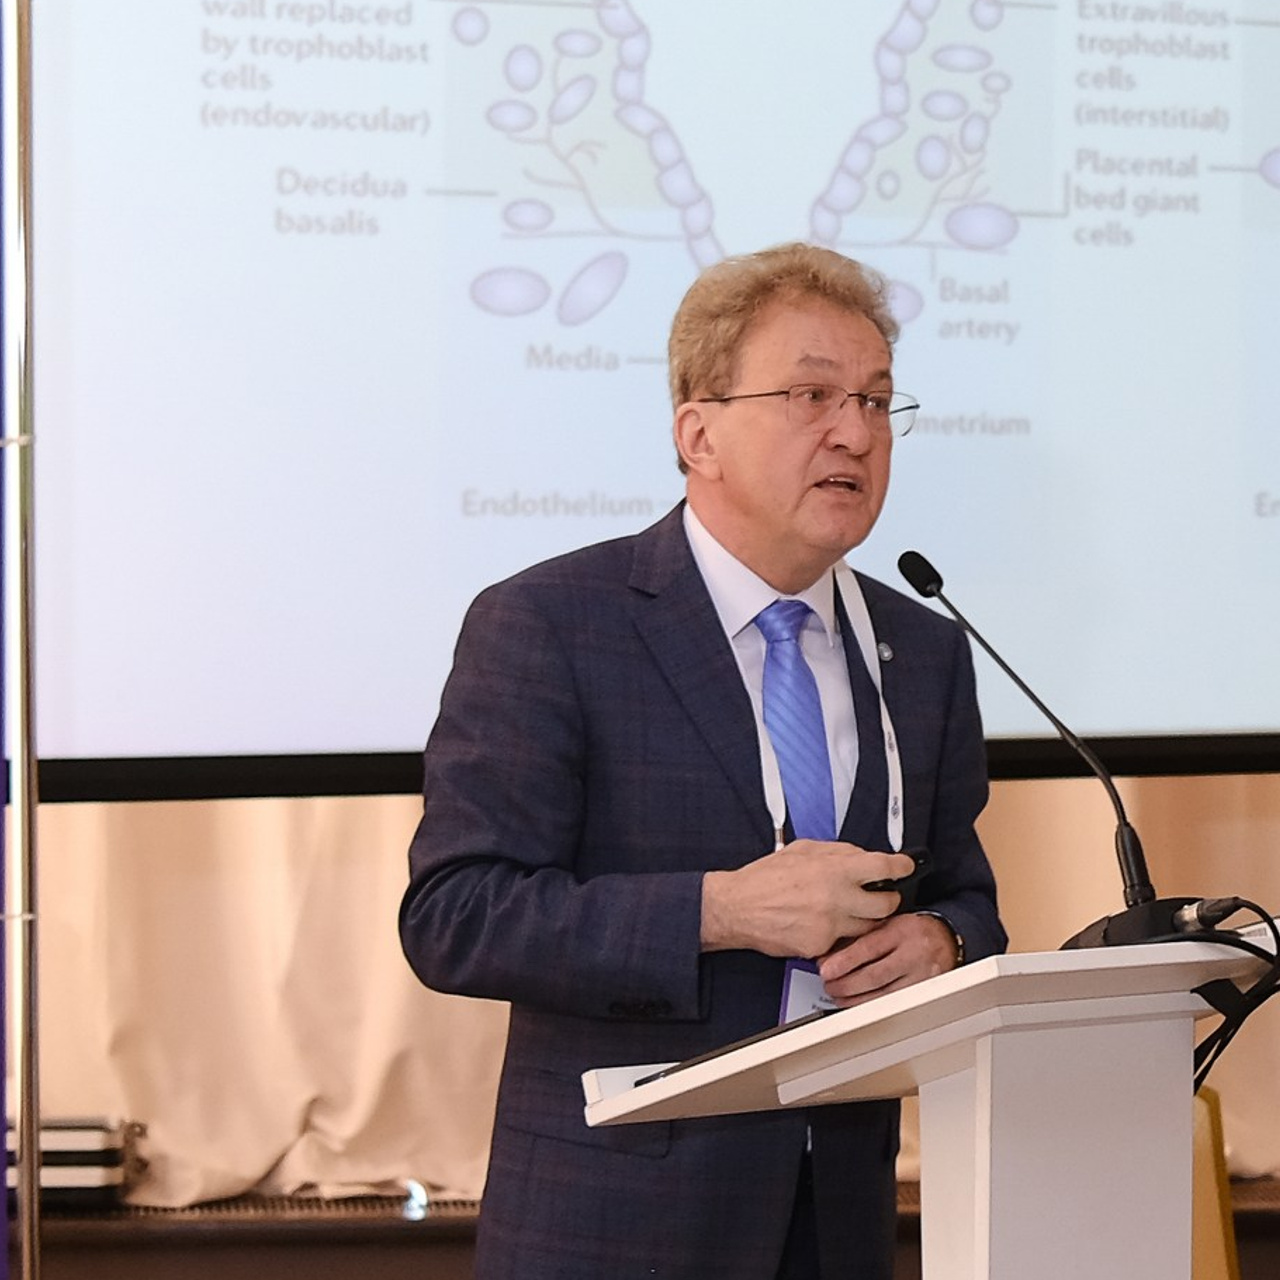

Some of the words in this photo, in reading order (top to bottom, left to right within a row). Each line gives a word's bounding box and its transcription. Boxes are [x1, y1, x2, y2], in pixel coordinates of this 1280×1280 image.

[200, 26, 239, 61] by
[248, 33, 429, 64] trophoblast
[1076, 32, 1231, 61] trophoblast
[200, 64, 273, 92] cells
[1075, 65, 1137, 91] cells
[200, 100, 431, 137] (endovascular)
[1074, 102, 1230, 133] (interstitial)
[1075, 147, 1199, 178] Placental
[275, 166, 409, 199] Decidua
[1074, 185, 1126, 211] bed
[1132, 190, 1200, 218] giant
[274, 208, 380, 236] basalis
[1073, 220, 1135, 247] cells
[939, 276, 1010, 304] Basal
[938, 319, 1021, 346] artery
[524, 342, 620, 374] Media
[916, 411, 1031, 435] metrium
[461, 487, 655, 517] Endothelium
